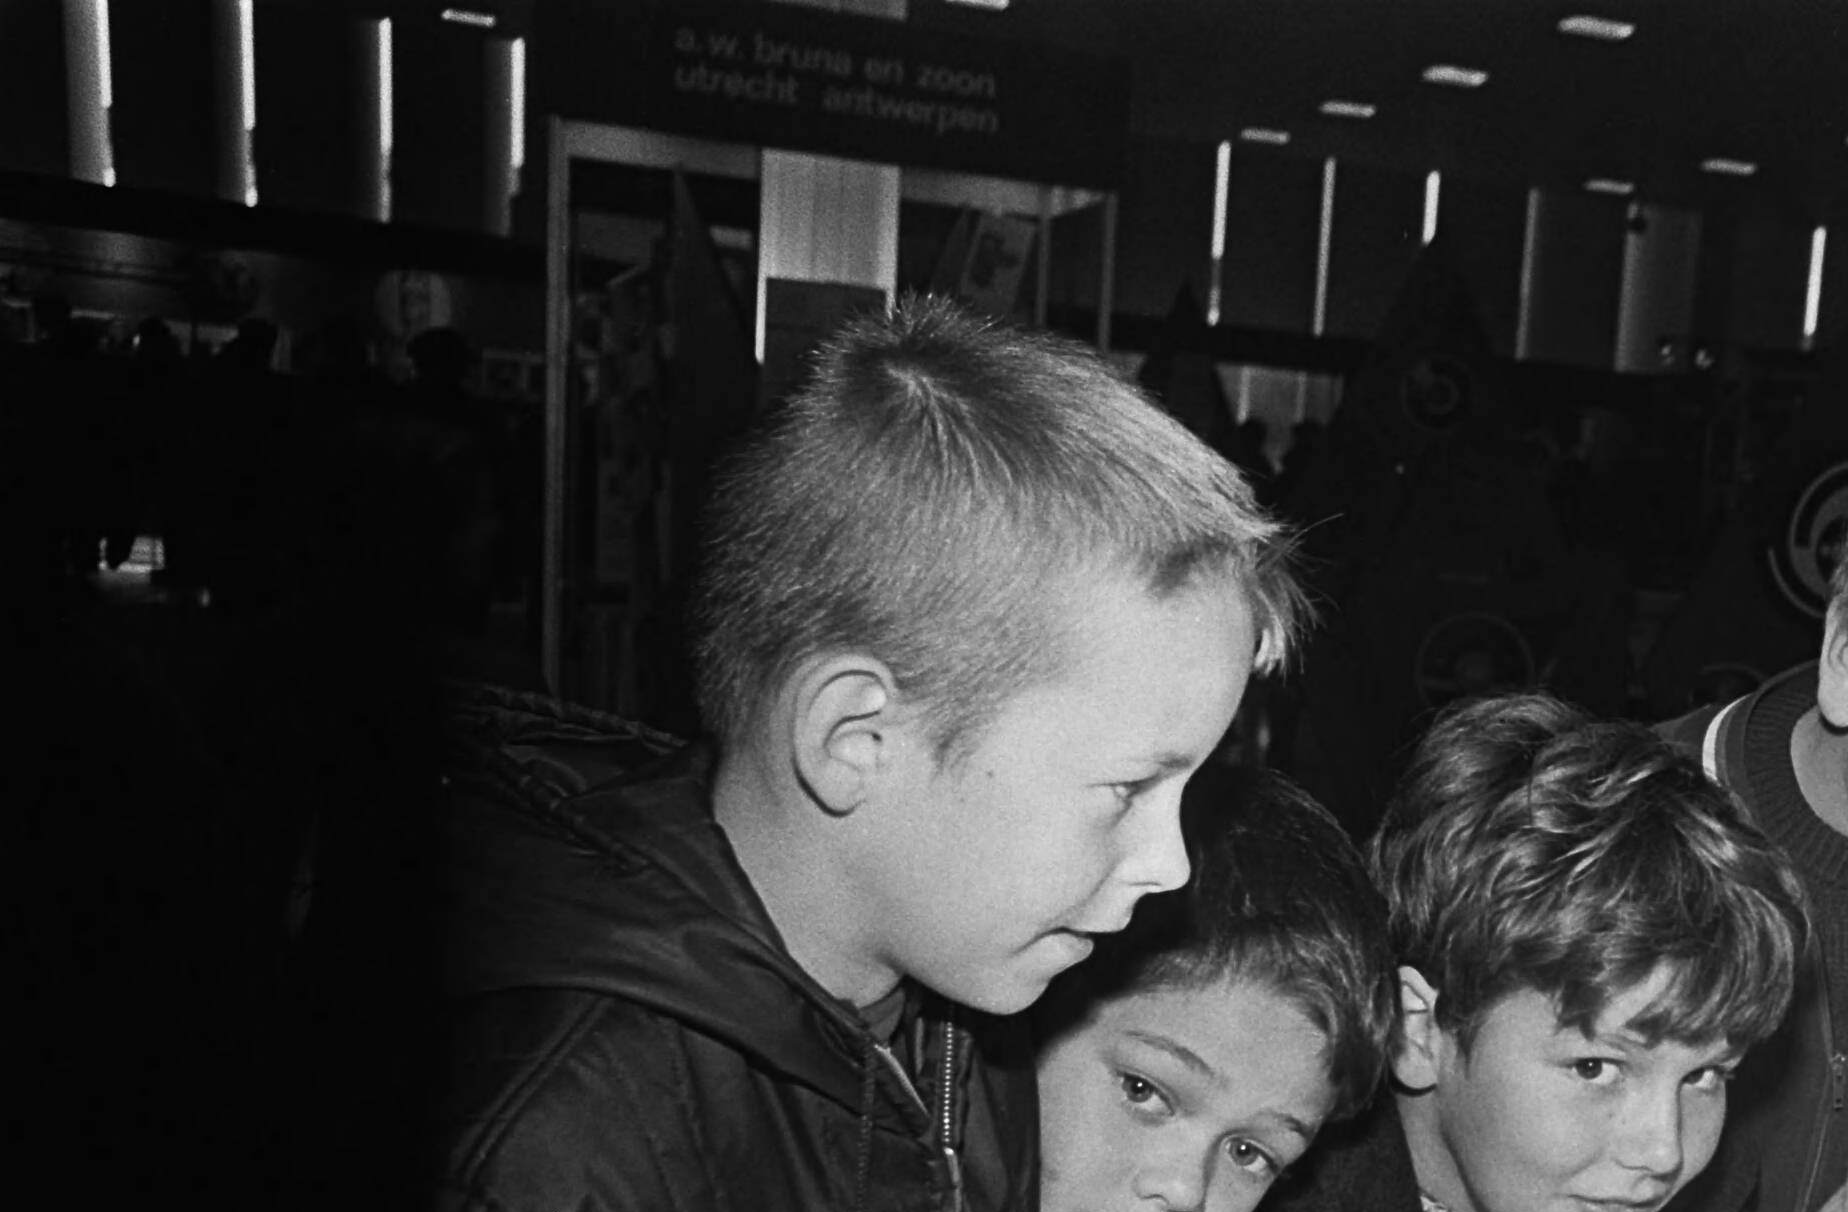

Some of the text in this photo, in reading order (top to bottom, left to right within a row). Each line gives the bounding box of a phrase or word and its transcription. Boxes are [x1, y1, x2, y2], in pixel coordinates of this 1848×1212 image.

[674, 63, 1000, 135] utrecht antwerpen
[754, 31, 851, 78] bruna
[863, 58, 904, 87] en
[916, 65, 997, 98] zoon
